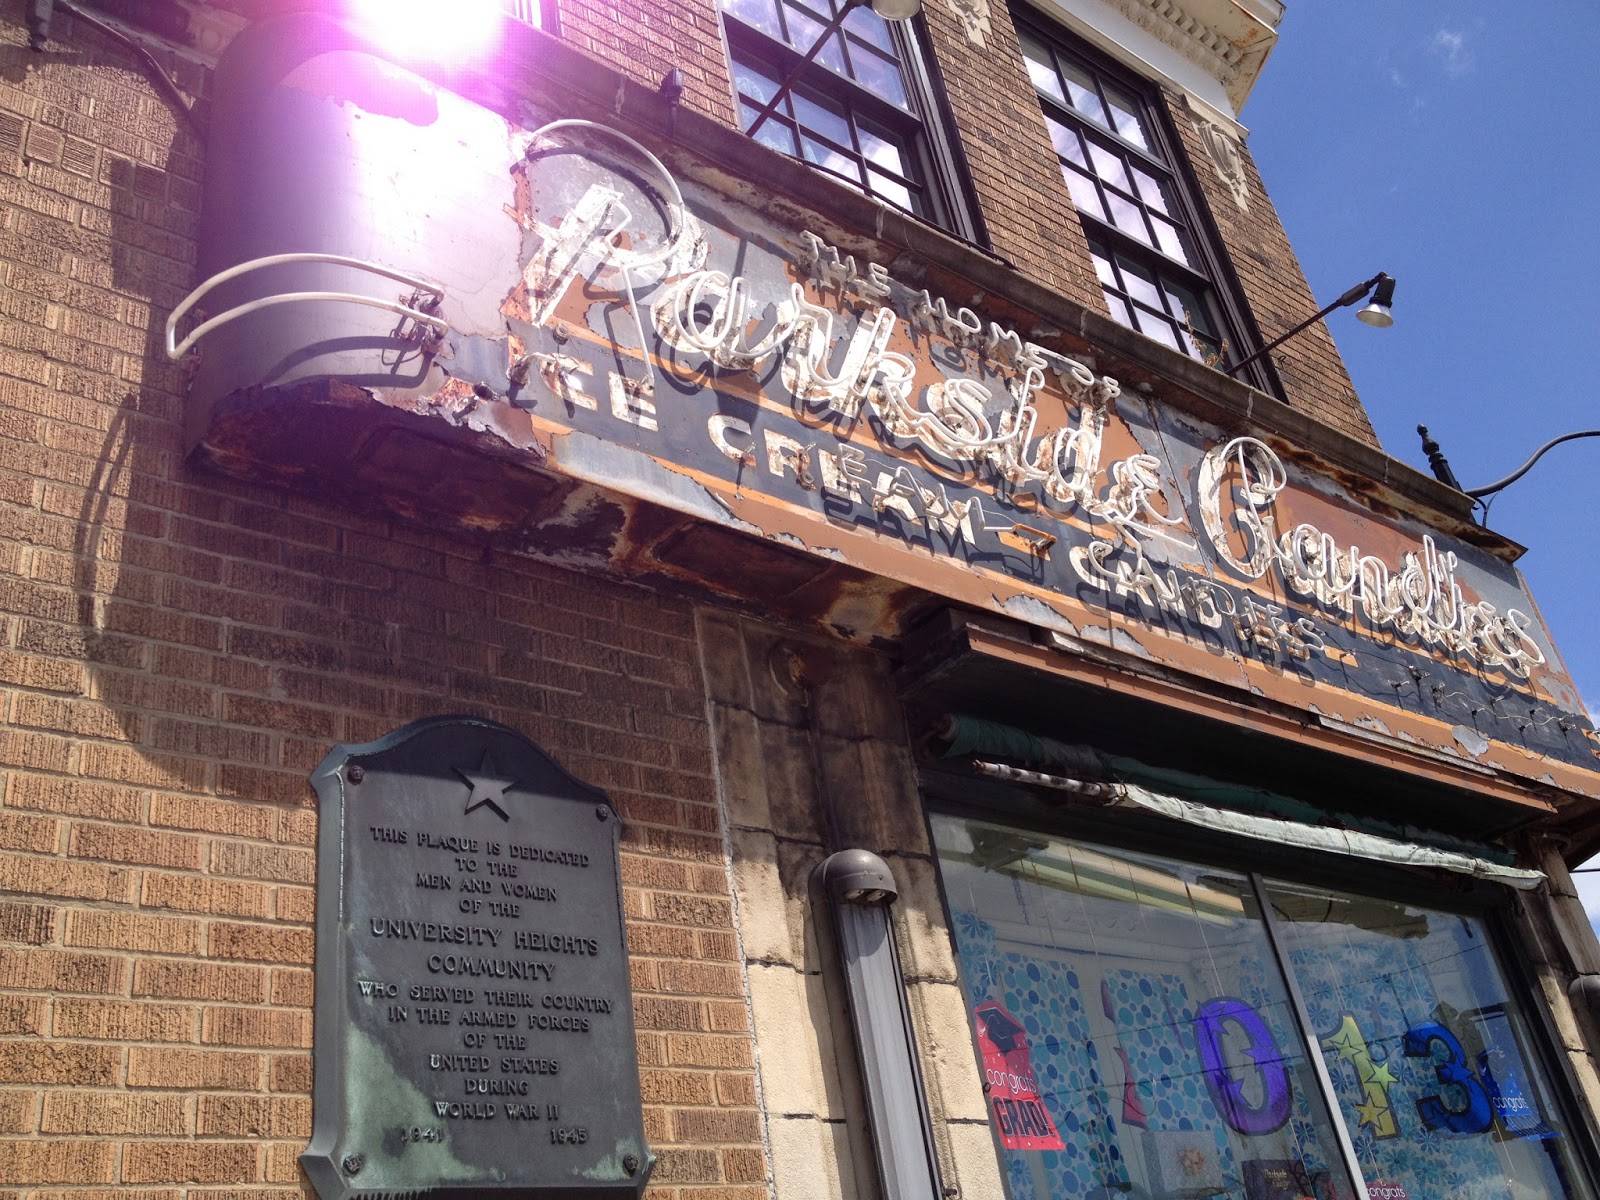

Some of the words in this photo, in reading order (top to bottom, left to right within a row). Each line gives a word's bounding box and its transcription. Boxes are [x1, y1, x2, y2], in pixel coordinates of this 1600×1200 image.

[503, 119, 1192, 536] Parkside
[1198, 436, 1546, 679] Candies
[707, 412, 988, 546] CREAM
[1069, 540, 1325, 661] CANDIES
[370, 826, 408, 844] THIS
[417, 832, 478, 853] PLAQUE
[487, 841, 501, 855] IS
[509, 844, 589, 867] DEDICATED
[455, 857, 478, 872] TO
[487, 861, 518, 878] THE
[416, 873, 451, 890] MEN
[460, 878, 492, 894] AND
[501, 882, 557, 902] WOMEN
[459, 899, 482, 914] OF
[489, 902, 520, 919] THE
[370, 918, 501, 947] UNIVERSITY
[514, 930, 600, 956] HEIGHTS
[428, 954, 556, 981] COMMUNITY
[357, 980, 398, 999] WHO
[410, 985, 475, 1002] SERVED
[484, 990, 534, 1008] THEIR
[542, 995, 613, 1014] COUNTRY
[388, 1006, 408, 1022] IN
[416, 1007, 451, 1025] THE
[459, 1010, 518, 1028] ARMED
[528, 1014, 591, 1032] FORCES
[463, 1033, 486, 1049] OF
[494, 1034, 526, 1050] THE
[430, 1054, 491, 1072] UNITED
[501, 1057, 560, 1076] STATES
[465, 1078, 529, 1096] DURING
[986, 1068, 1037, 1095] congrats
[434, 1101, 497, 1120] WORLD
[505, 1103, 540, 1121] WAR
[547, 1104, 559, 1121] II
[992, 1095, 1055, 1138] GRAD!
[401, 1126, 445, 1144] 1941
[551, 1128, 587, 1144] 1945
